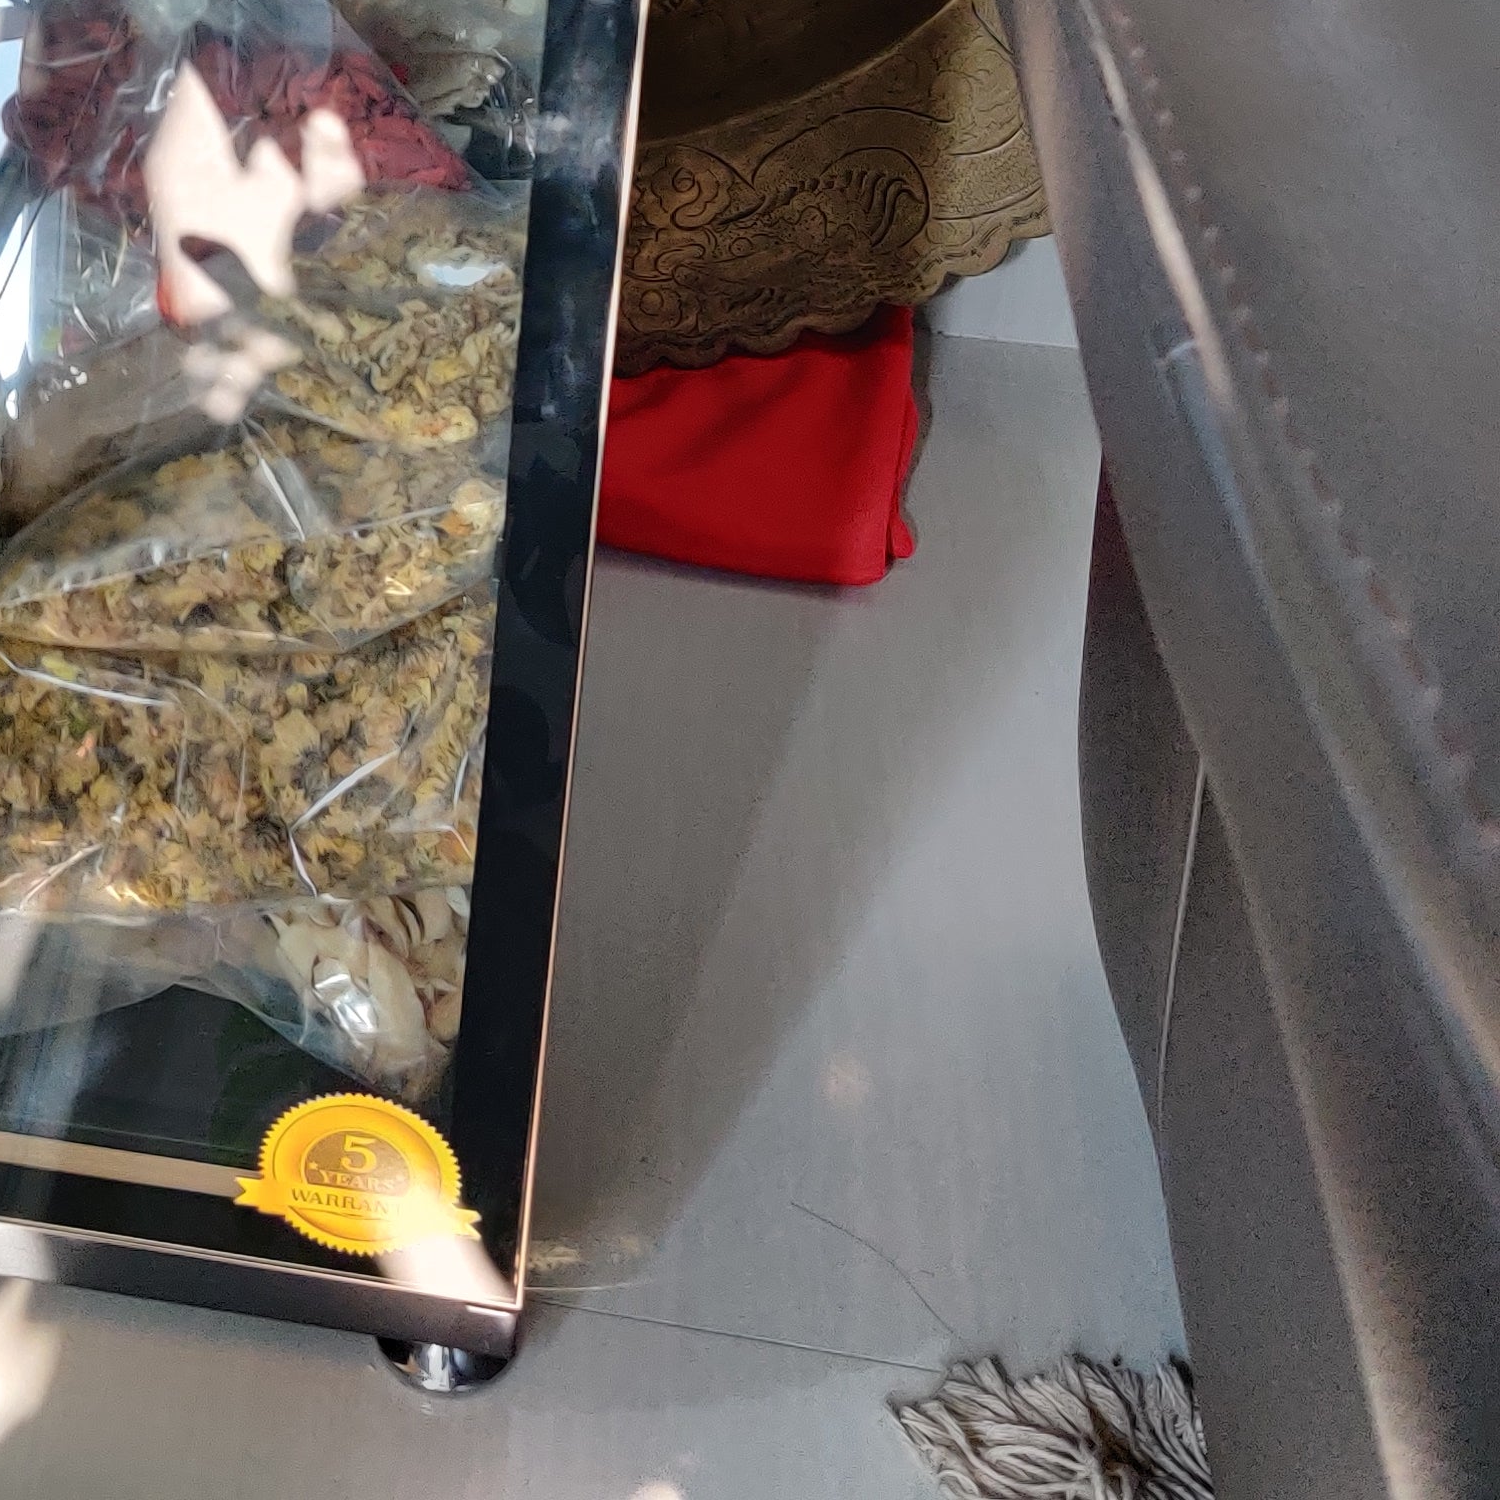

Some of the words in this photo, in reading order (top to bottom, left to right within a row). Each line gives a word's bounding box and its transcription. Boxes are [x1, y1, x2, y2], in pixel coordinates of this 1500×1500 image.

[340, 1133, 378, 1174] 5
[317, 1169, 397, 1191] YEARS
[291, 1187, 402, 1216] WARRAN
